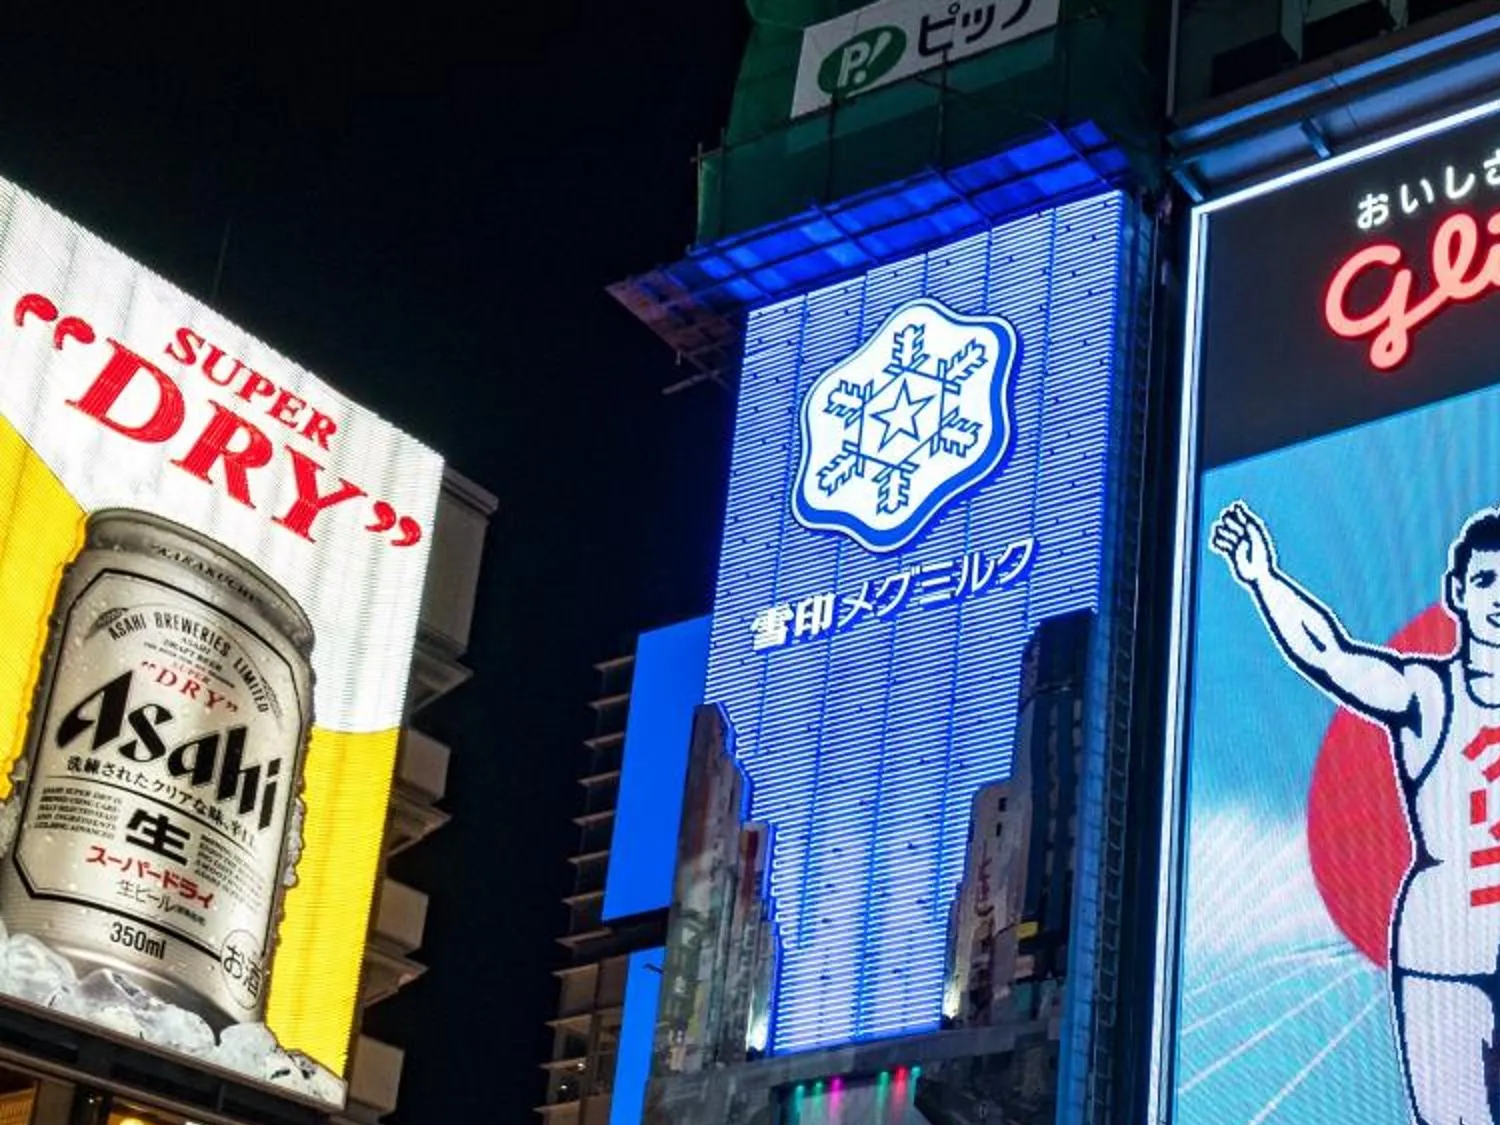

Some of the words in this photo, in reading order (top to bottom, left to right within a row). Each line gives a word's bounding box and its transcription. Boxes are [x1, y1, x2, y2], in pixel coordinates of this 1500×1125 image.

[164, 326, 338, 452] SUPER
[750, 537, 1035, 650] 雪印メグミルク
[108, 612, 147, 642] ASAHI
[154, 611, 232, 657] BREWERIES
[233, 656, 270, 714] LIMITED
[55, 669, 282, 832] Asahi
[125, 808, 191, 868] 生
[86, 844, 216, 911] スーパードライ
[116, 879, 176, 914] 生ビール
[110, 921, 168, 961] 350ml
[222, 943, 264, 1000] お酒
